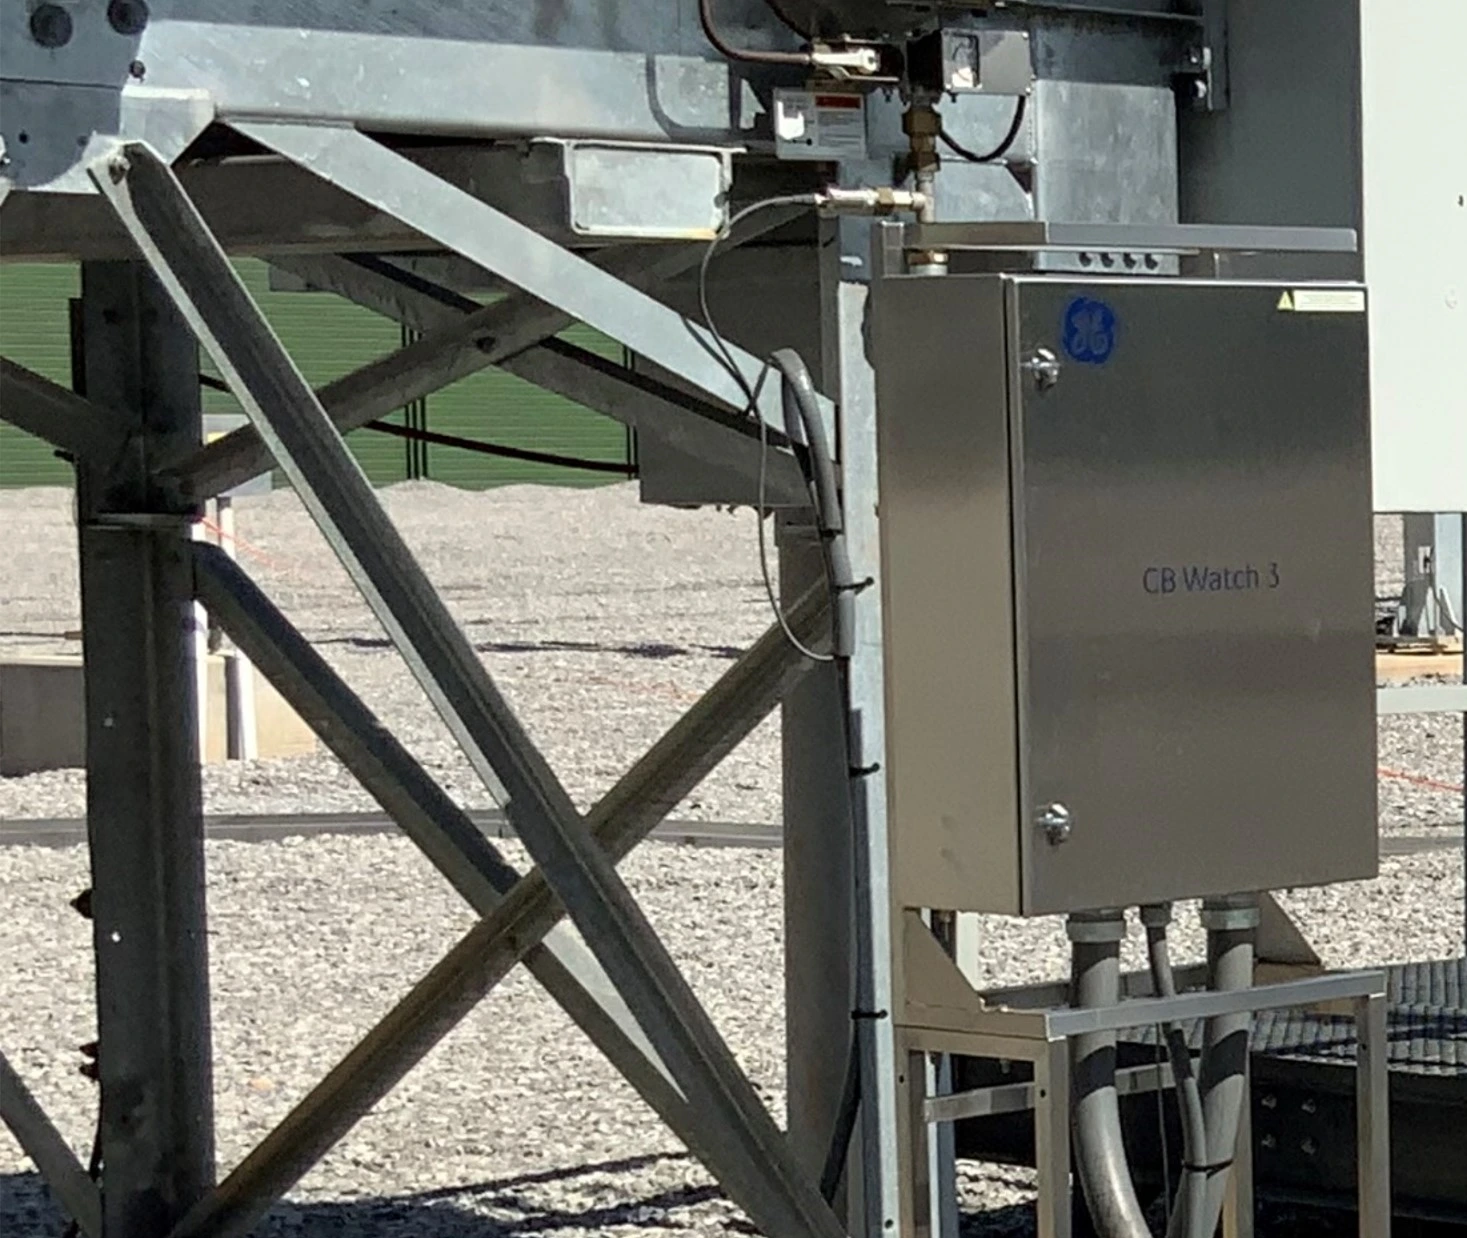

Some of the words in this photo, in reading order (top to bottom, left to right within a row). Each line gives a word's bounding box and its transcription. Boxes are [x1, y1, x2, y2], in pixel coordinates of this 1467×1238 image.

[1143, 567, 1177, 594] CB
[1182, 564, 1260, 592] Watch
[1268, 562, 1280, 589] 3
